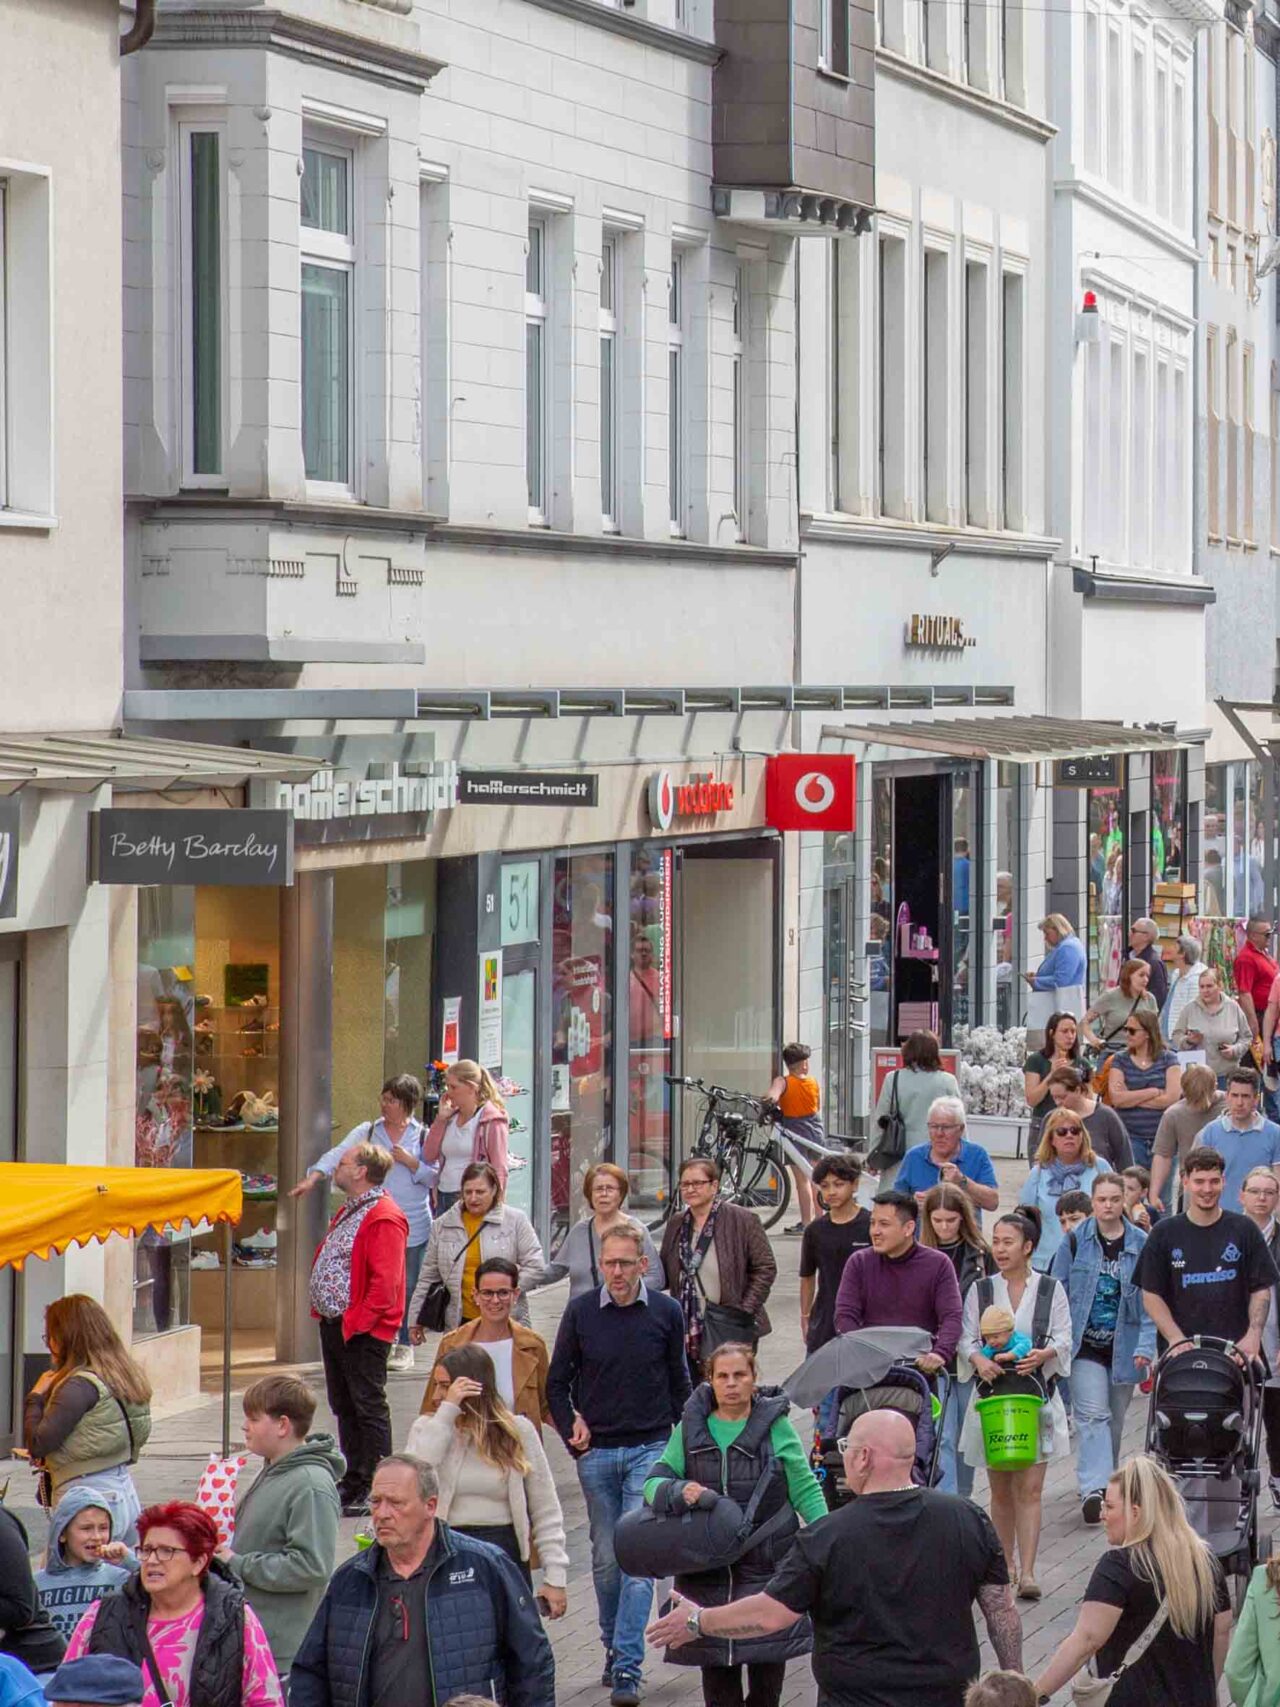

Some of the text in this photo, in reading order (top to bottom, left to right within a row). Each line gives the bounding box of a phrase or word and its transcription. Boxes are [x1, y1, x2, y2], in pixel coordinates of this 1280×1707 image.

[676, 771, 734, 815] vodafone
[110, 832, 278, 873] Betty Barclay
[486, 894, 494, 913] 51
[508, 873, 529, 931] 51
[1183, 1266, 1236, 1288] paraiso
[39, 1586, 106, 1606] RIGINA
